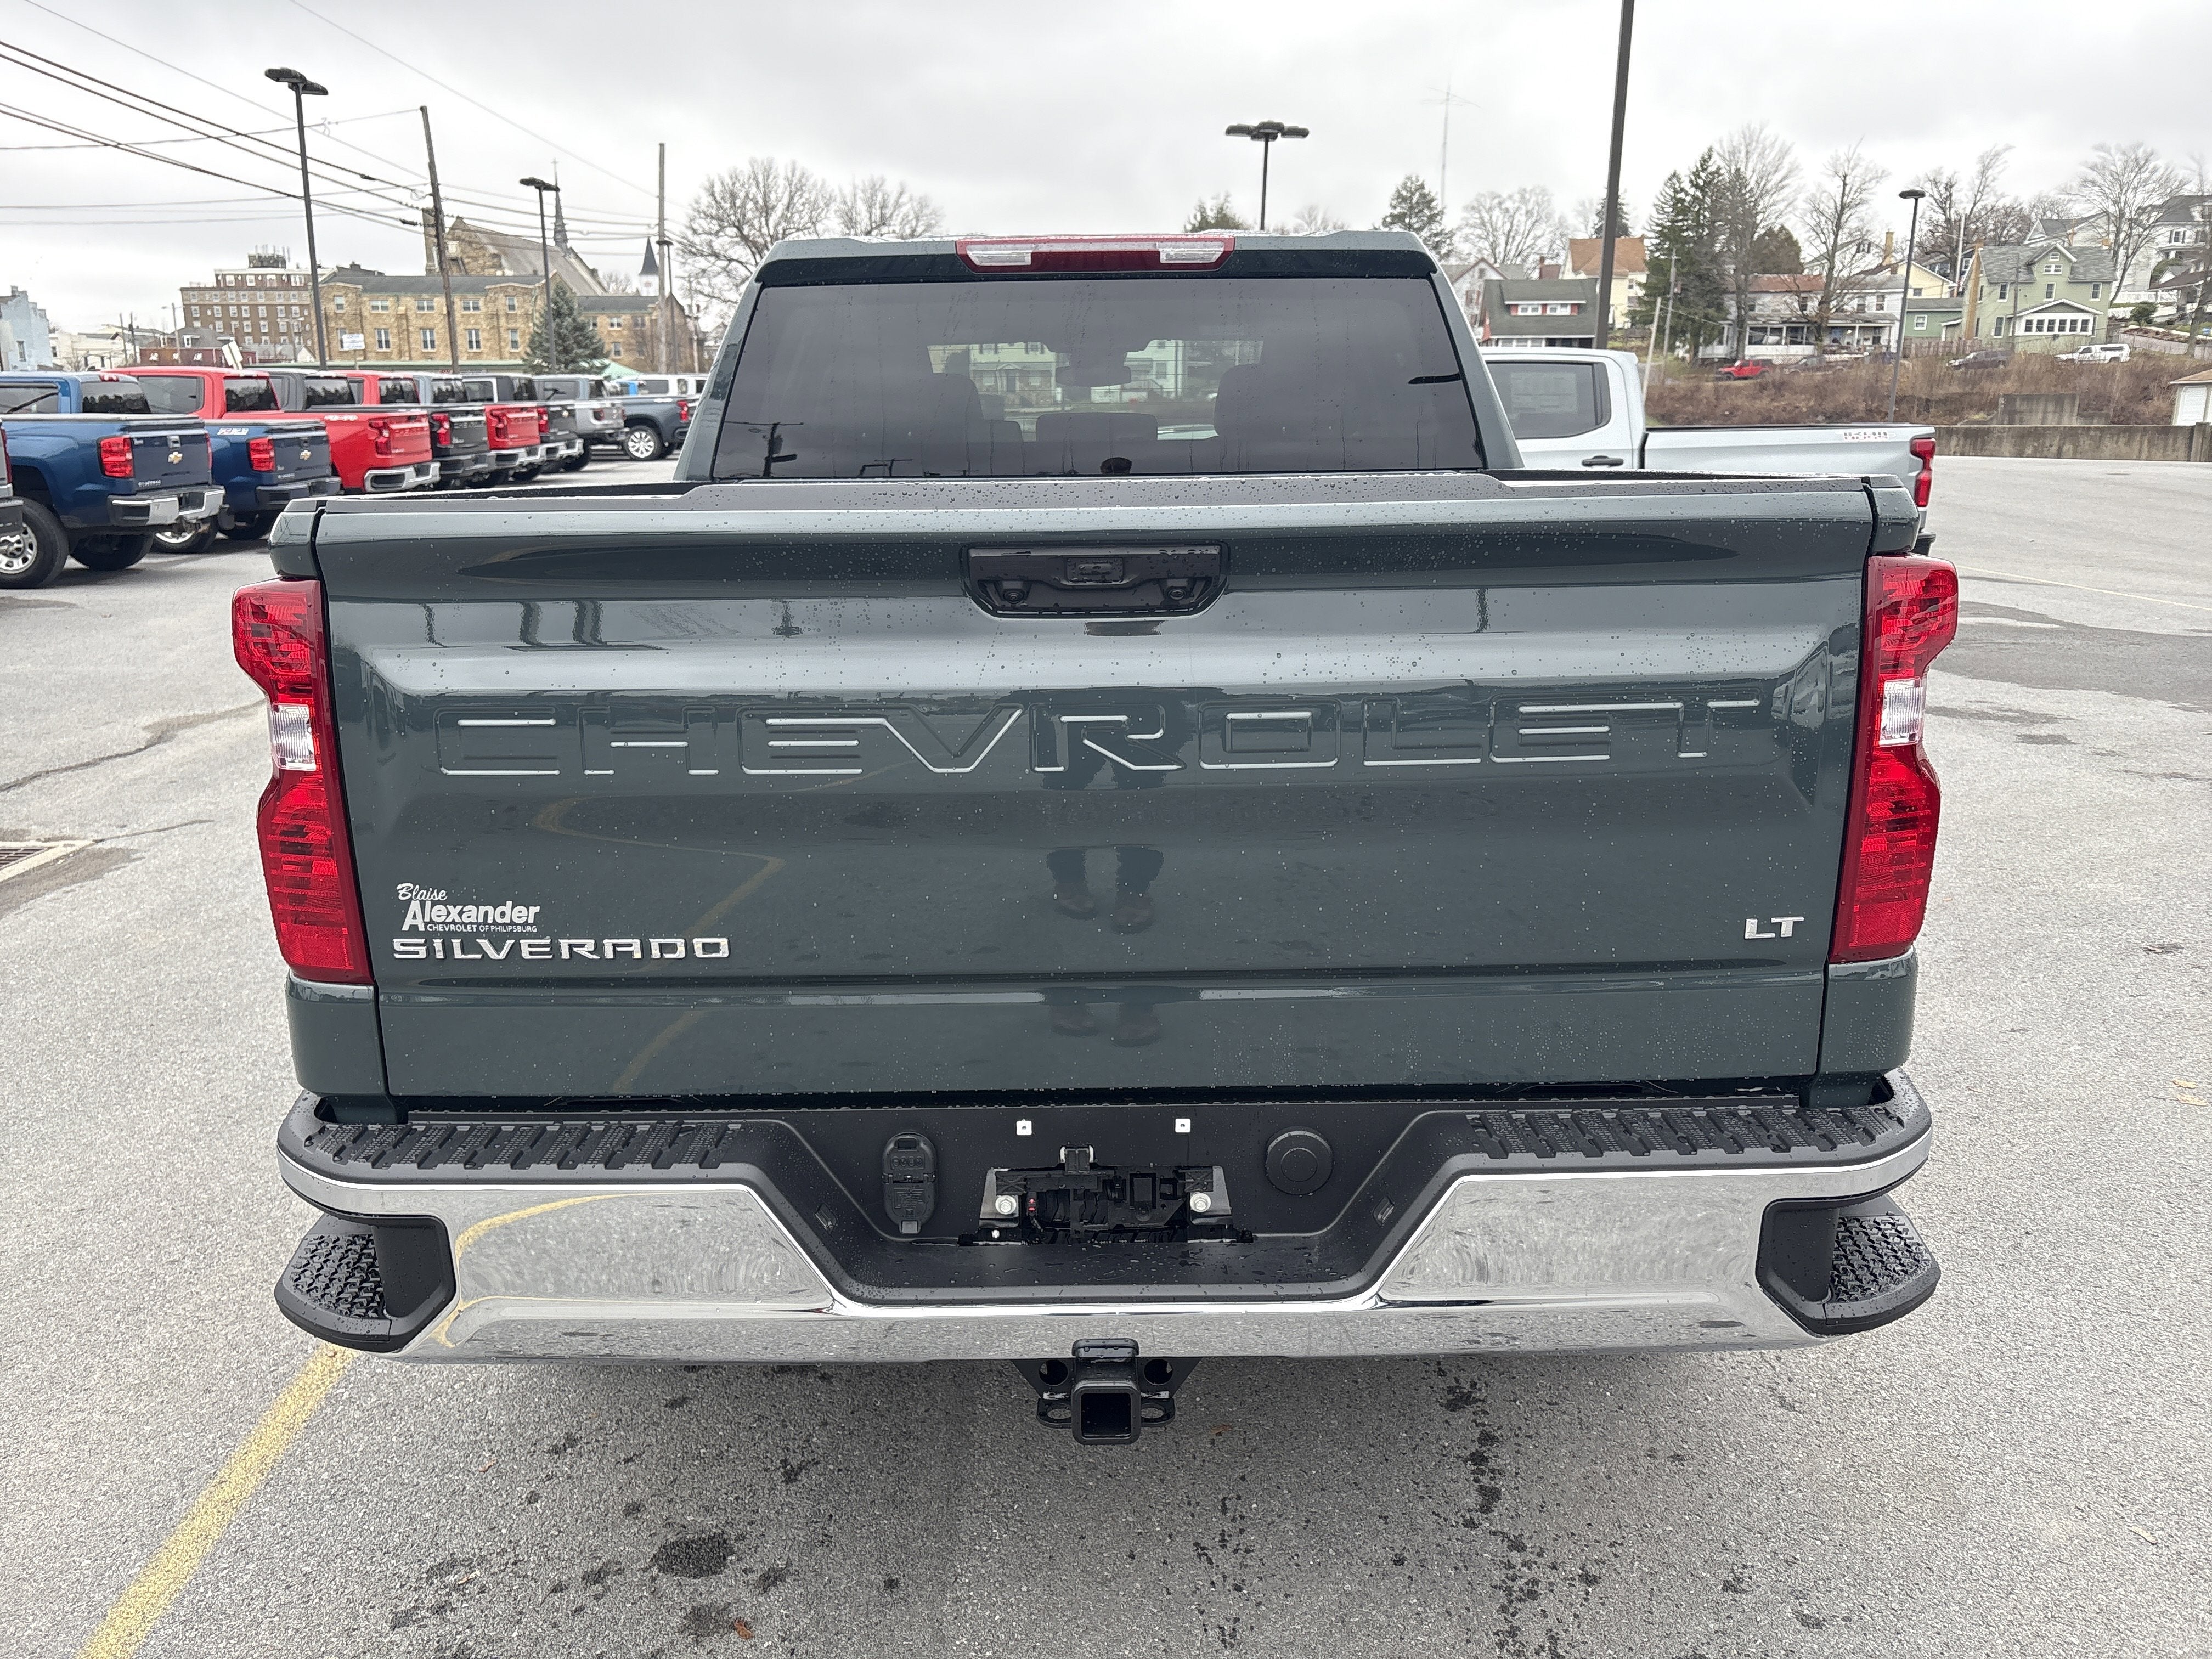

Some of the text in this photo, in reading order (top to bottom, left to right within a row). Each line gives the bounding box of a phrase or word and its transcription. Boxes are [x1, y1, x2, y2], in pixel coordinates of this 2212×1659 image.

[433, 687, 1763, 776] CHEVROLET
[396, 883, 448, 901] Blaise
[401, 900, 540, 931] Alexander
[427, 923, 538, 933] CHEVROLET OF PHILIPSBURG
[1744, 916, 1805, 939] LT
[392, 938, 730, 960] SILVERADO
